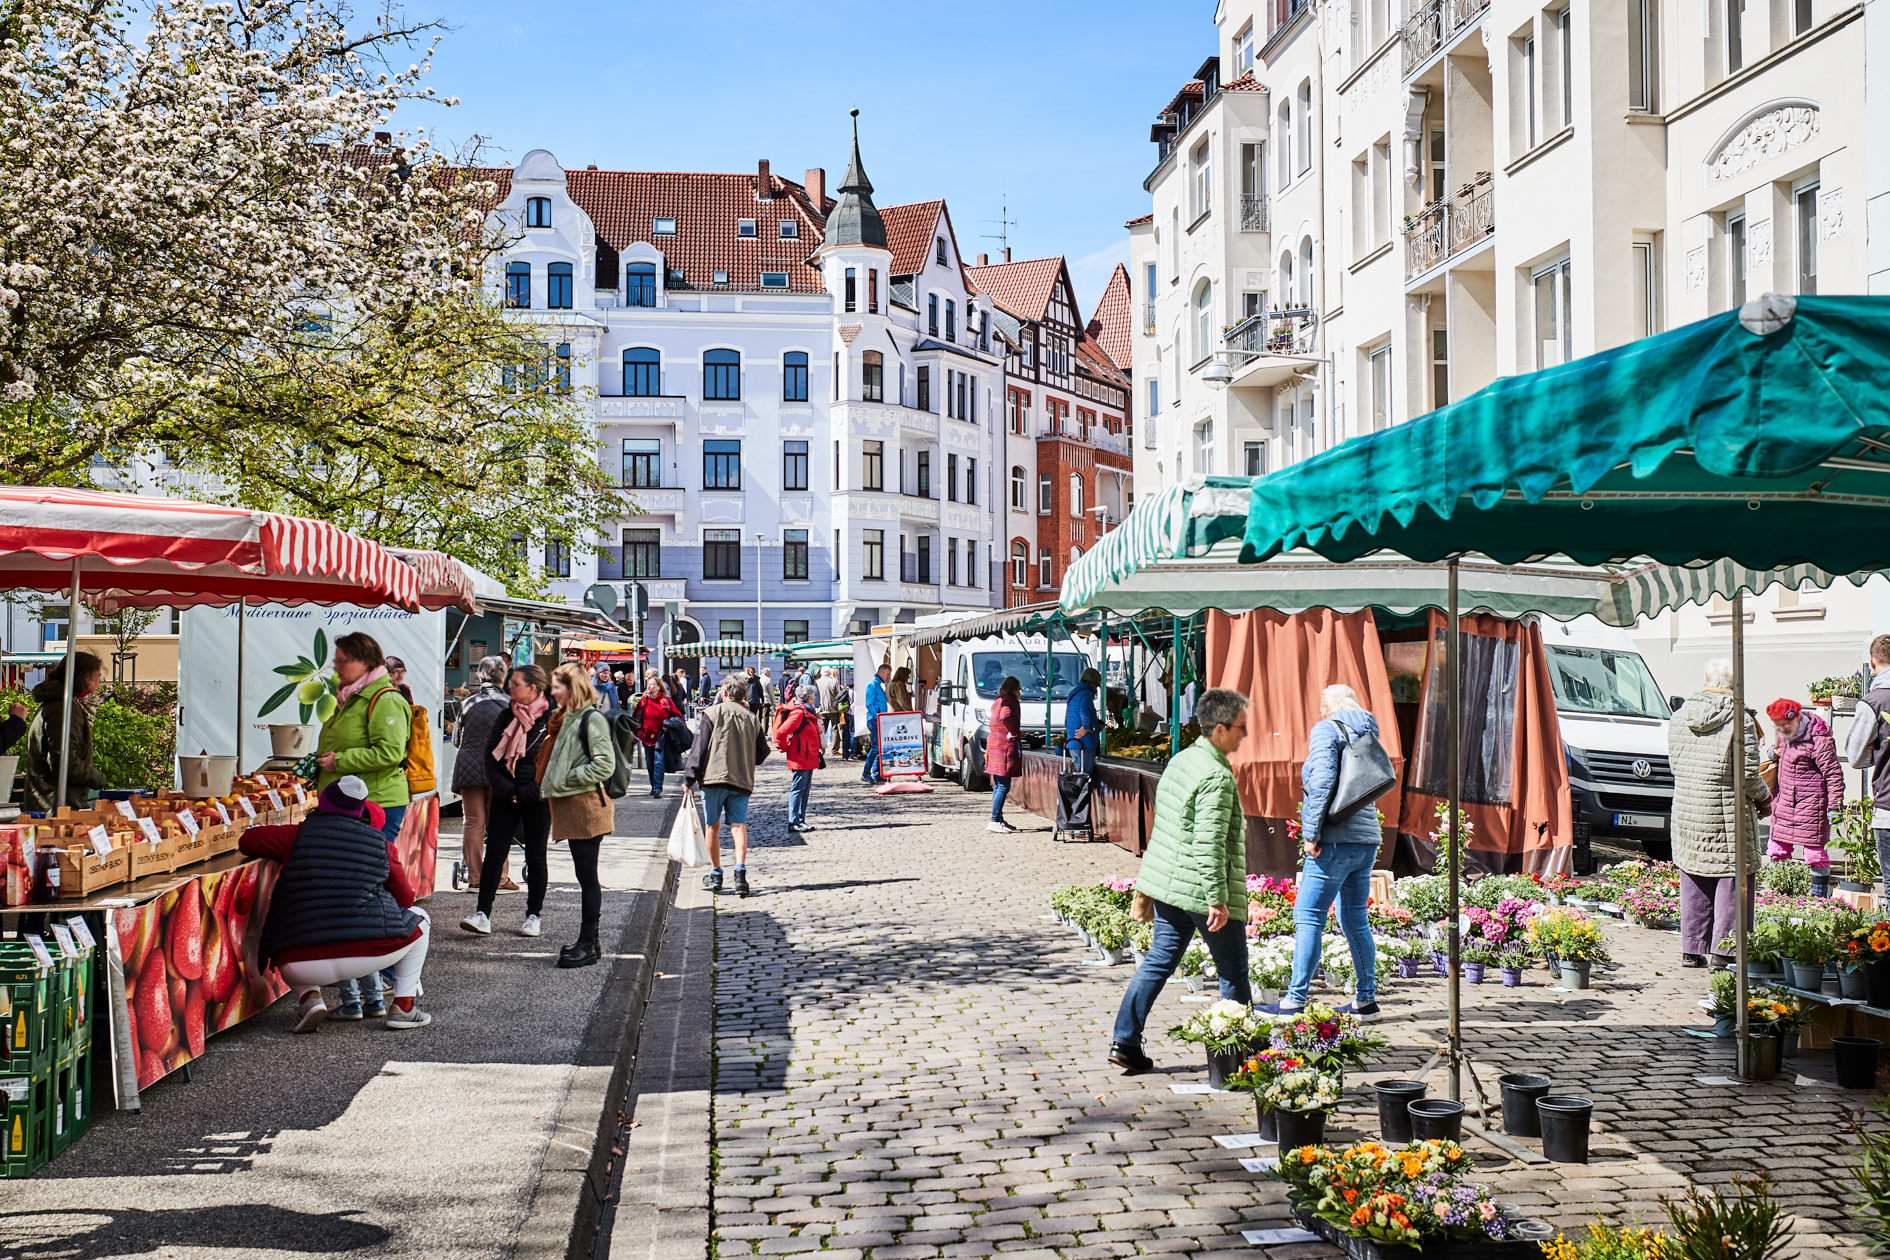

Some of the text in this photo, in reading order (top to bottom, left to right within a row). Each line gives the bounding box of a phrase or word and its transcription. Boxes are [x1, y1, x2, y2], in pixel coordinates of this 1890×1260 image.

[216, 603, 414, 626] Mditerrane Spezialitäten
[884, 734, 919, 742] ITALDRIVE
